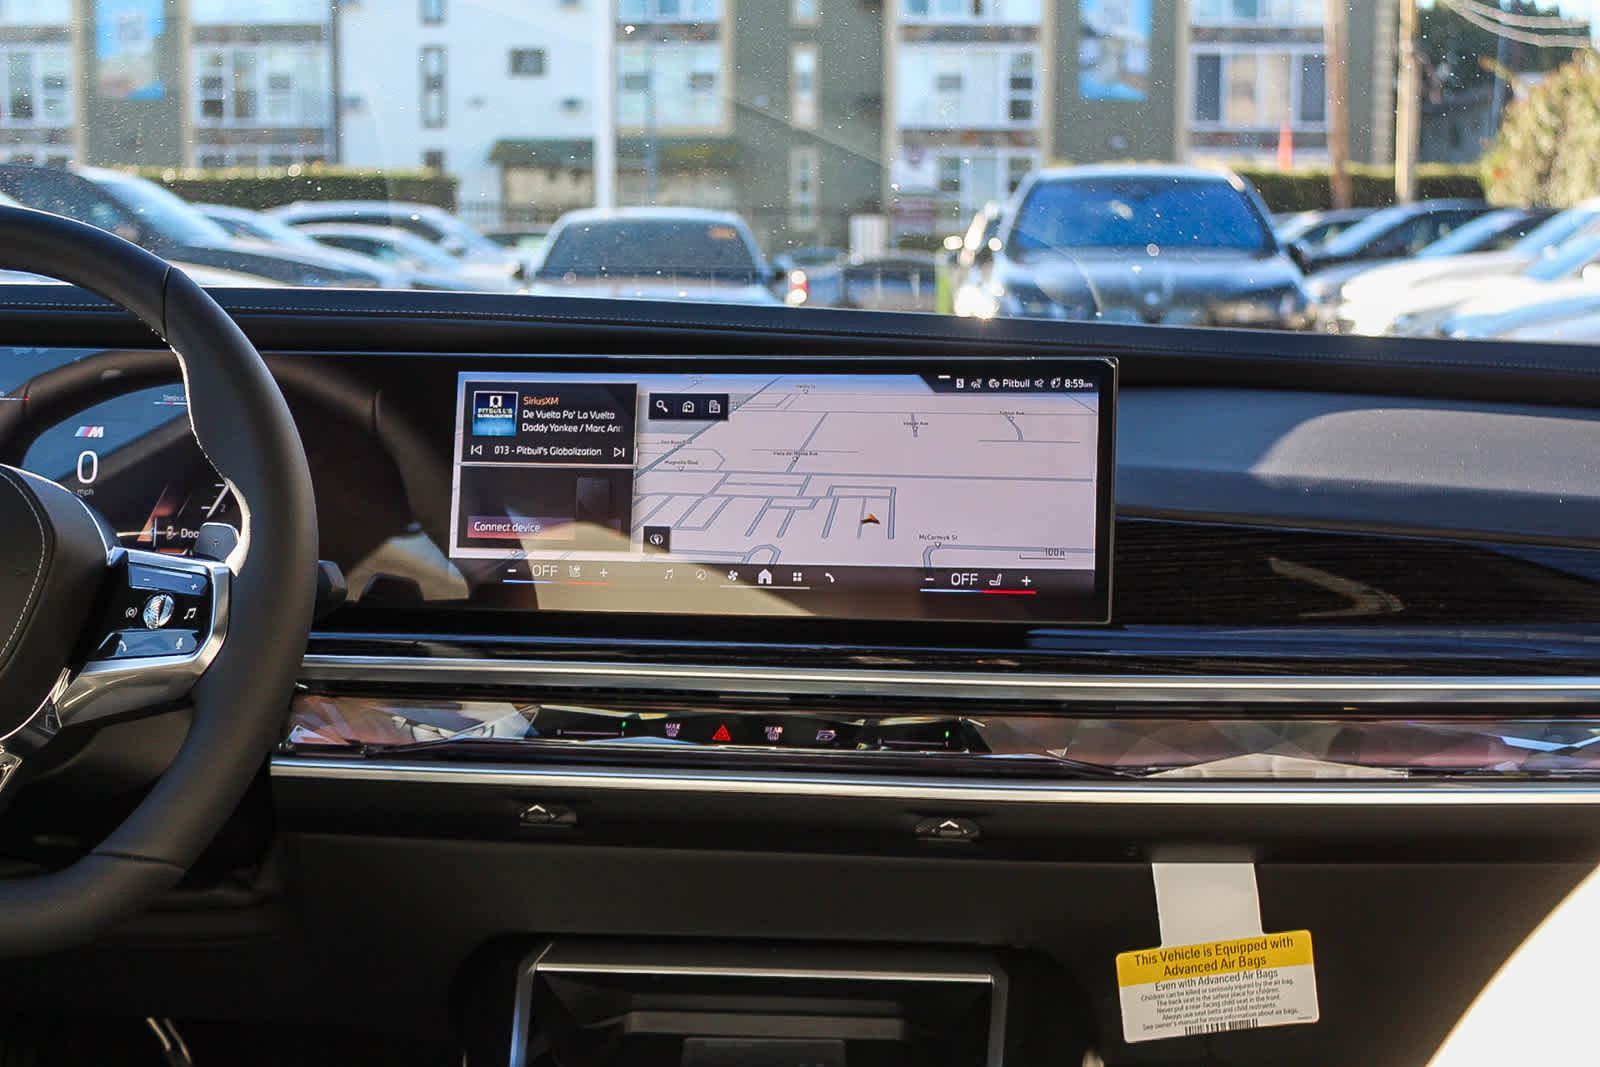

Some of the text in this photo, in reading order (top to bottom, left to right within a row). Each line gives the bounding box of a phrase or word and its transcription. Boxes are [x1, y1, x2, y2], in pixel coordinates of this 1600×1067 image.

[1003, 378, 1030, 388] Pitbull
[523, 396, 559, 405] SiriusXM
[522, 410, 534, 418] De
[536, 410, 560, 419] Vuelta
[577, 410, 588, 419] La
[589, 411, 615, 420] Vuelta
[522, 423, 548, 433] Daddy
[549, 423, 578, 432] Yankee
[585, 424, 605, 432] Marc
[495, 446, 509, 454] 013
[517, 447, 547, 455] Pitbull's
[549, 447, 602, 456] Globalization
[77, 450, 98, 484] 0
[77, 489, 94, 497] mph
[473, 521, 541, 533] Connect device
[532, 565, 558, 577] OFF
[951, 573, 978, 585] OFF
[1135, 936, 1294, 966] This Vehicle is Equipped with
[1164, 955, 1266, 976] Advanced Air Bags
[1155, 969, 1278, 991] Even with Advanced Air Bags
[1141, 992, 1165, 1001] Children
